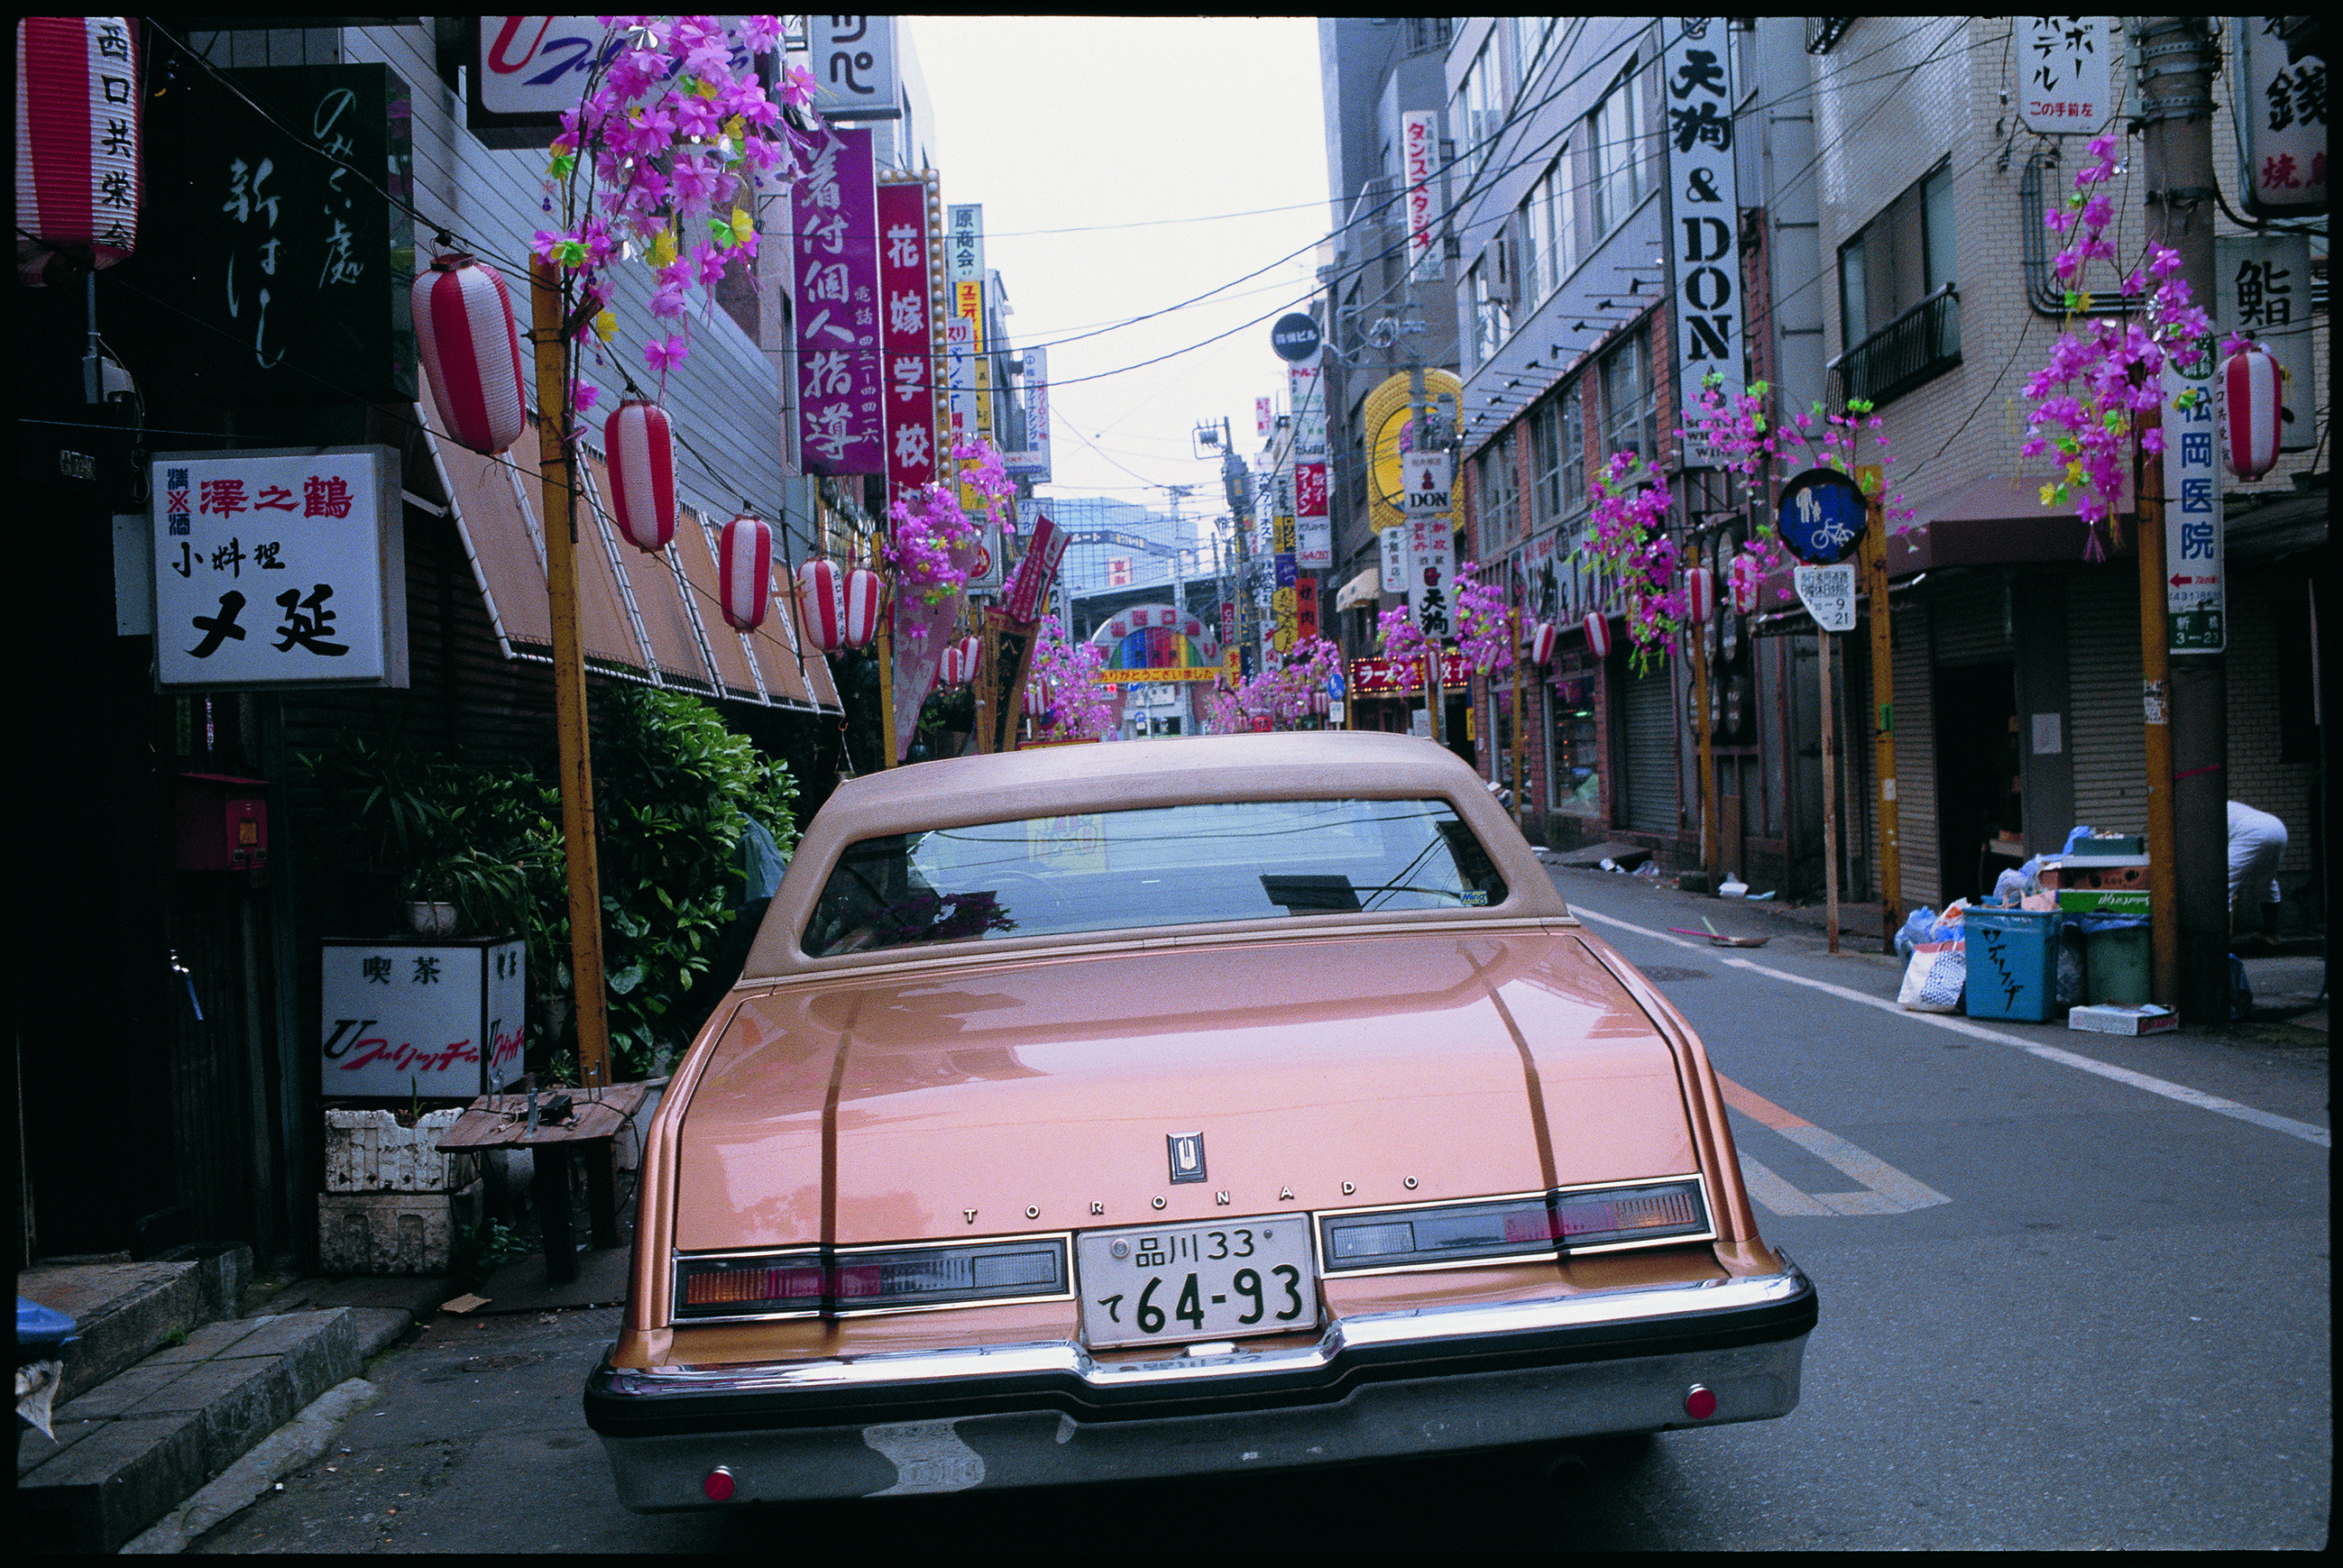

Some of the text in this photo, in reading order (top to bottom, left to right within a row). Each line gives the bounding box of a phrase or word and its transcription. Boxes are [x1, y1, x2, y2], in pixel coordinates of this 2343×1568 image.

[1668, 50, 1731, 153] 天狗
[2030, 101, 2093, 116] この手前左
[1408, 122, 1431, 248] ダンススタジオ
[1686, 167, 1721, 202] &
[800, 138, 862, 461] 着付個人指導
[1682, 216, 1732, 361] DON
[2237, 260, 2291, 326] 鮨
[887, 223, 932, 502] 花嫁学校
[199, 475, 354, 519] 澤之鶴
[1297, 466, 1311, 515] ラーメン
[1410, 492, 1448, 508] DON
[172, 536, 286, 578] 小料理
[1420, 588, 1448, 635] 天狗
[363, 956, 441, 985] 喫茶
[963, 1175, 1419, 1224] TORONADO
[1098, 1263, 1303, 1334] て 64-93
